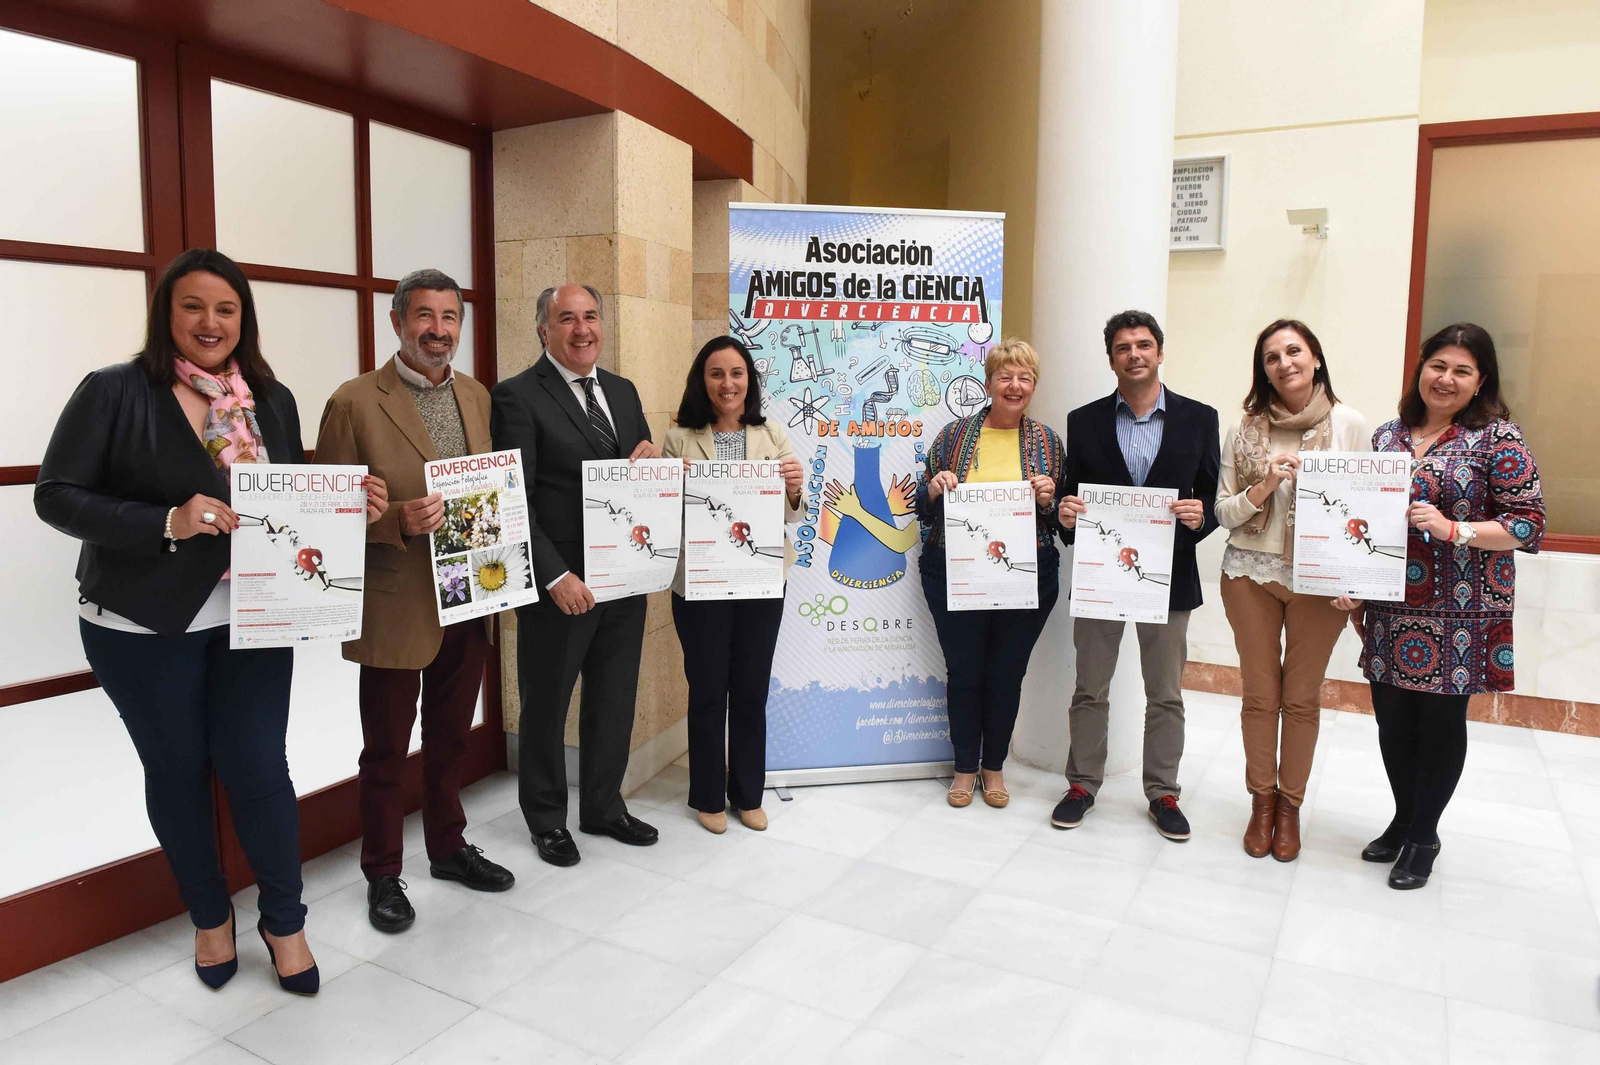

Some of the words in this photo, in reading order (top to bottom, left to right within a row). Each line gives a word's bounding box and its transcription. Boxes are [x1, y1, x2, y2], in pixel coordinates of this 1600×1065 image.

[1173, 166, 1214, 174] AMPLIACION
[805, 236, 932, 266] Asociación
[745, 270, 836, 314] AMIGOS
[842, 273, 870, 299] de
[876, 273, 896, 300] la
[902, 275, 986, 319] CIENCIA
[764, 302, 972, 320] DIVERCIENCIA
[817, 420, 840, 437] DE
[430, 454, 517, 478] DIVERCIENCIA
[588, 466, 680, 481] DIVERCIENCIA
[689, 464, 782, 478] DIVERCIENCIA
[1303, 458, 1406, 474] DIVERCIENCIA
[239, 473, 362, 492] DIVERCIENCIA
[949, 487, 1032, 503] DIVERCIENCIA
[1083, 490, 1174, 508] DIVERCIENCIA
